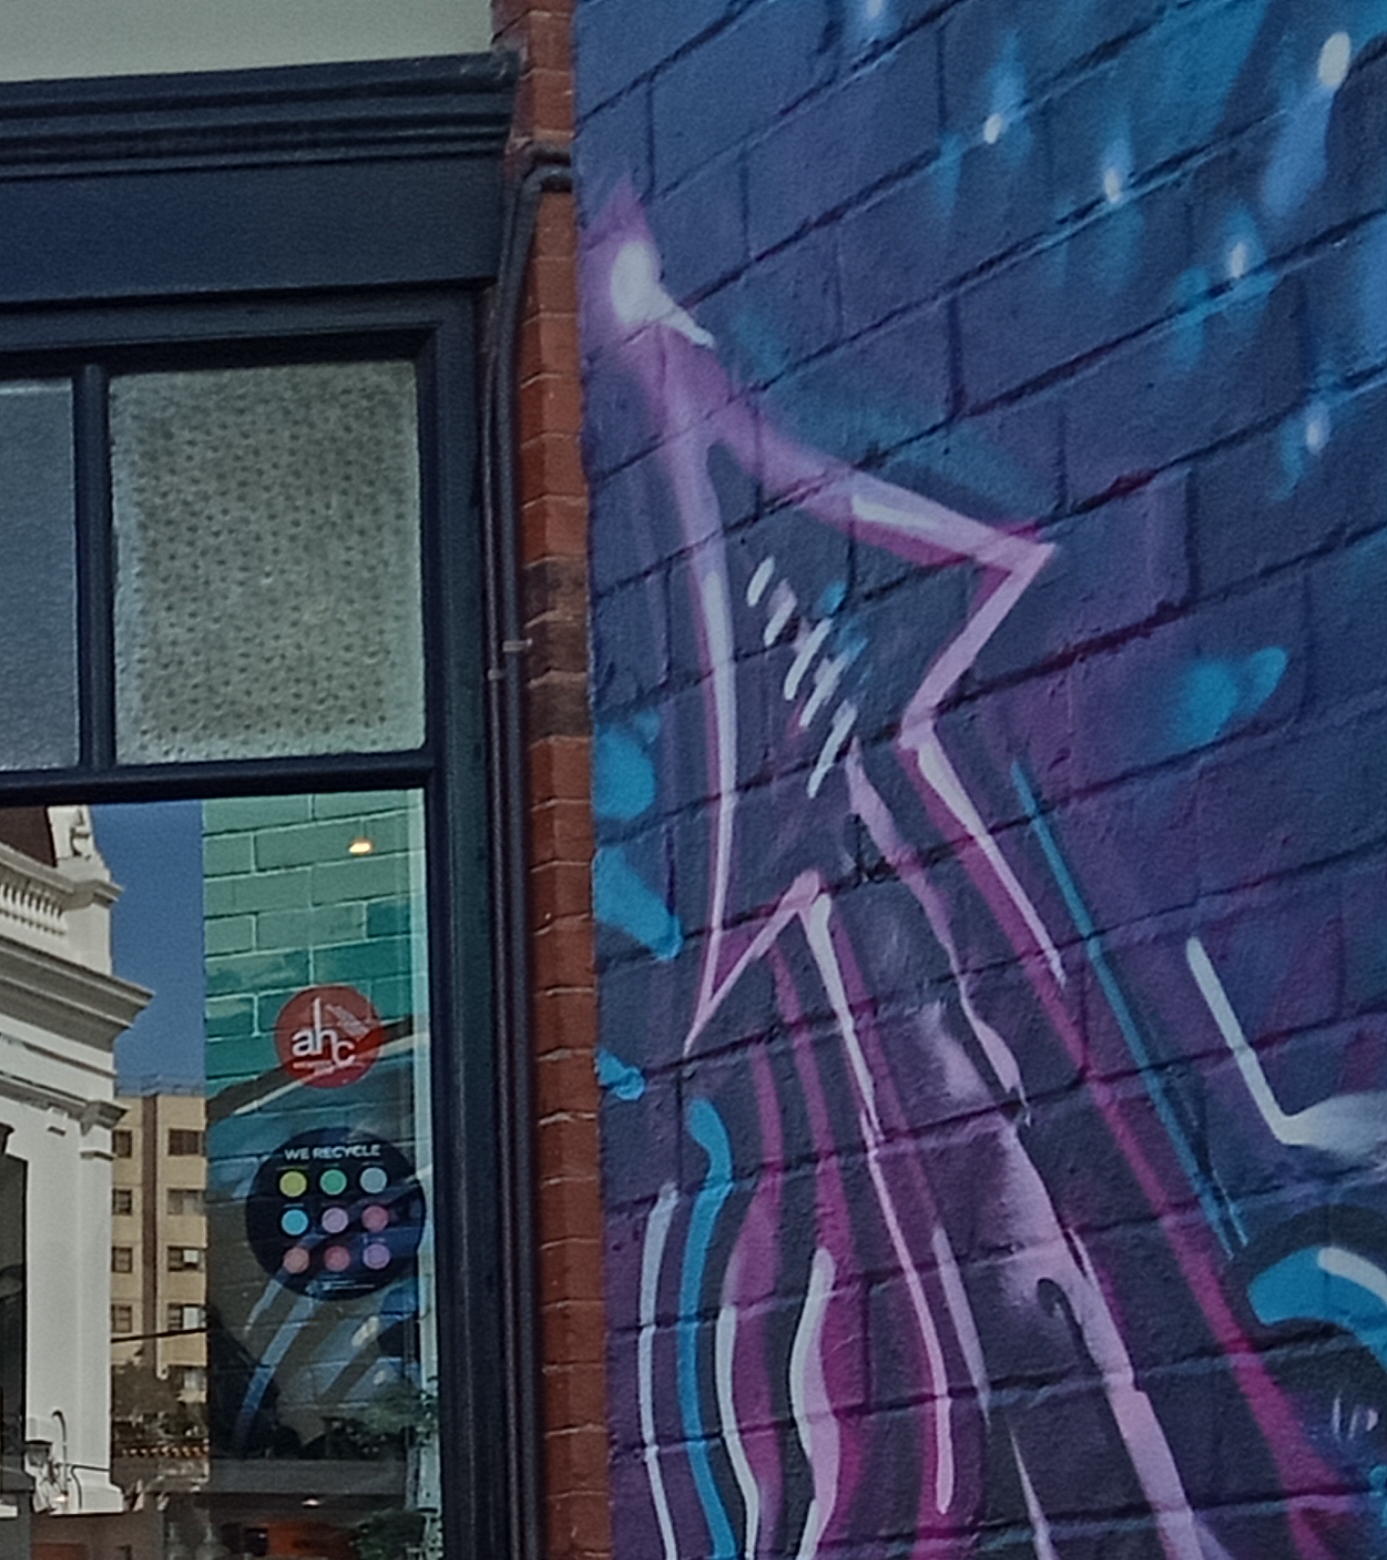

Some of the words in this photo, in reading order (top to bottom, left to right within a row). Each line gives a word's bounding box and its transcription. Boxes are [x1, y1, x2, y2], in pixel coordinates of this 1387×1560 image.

[291, 997, 357, 1067] ahc
[284, 1147, 310, 1161] WE
[312, 1144, 382, 1159] RECYCLE
